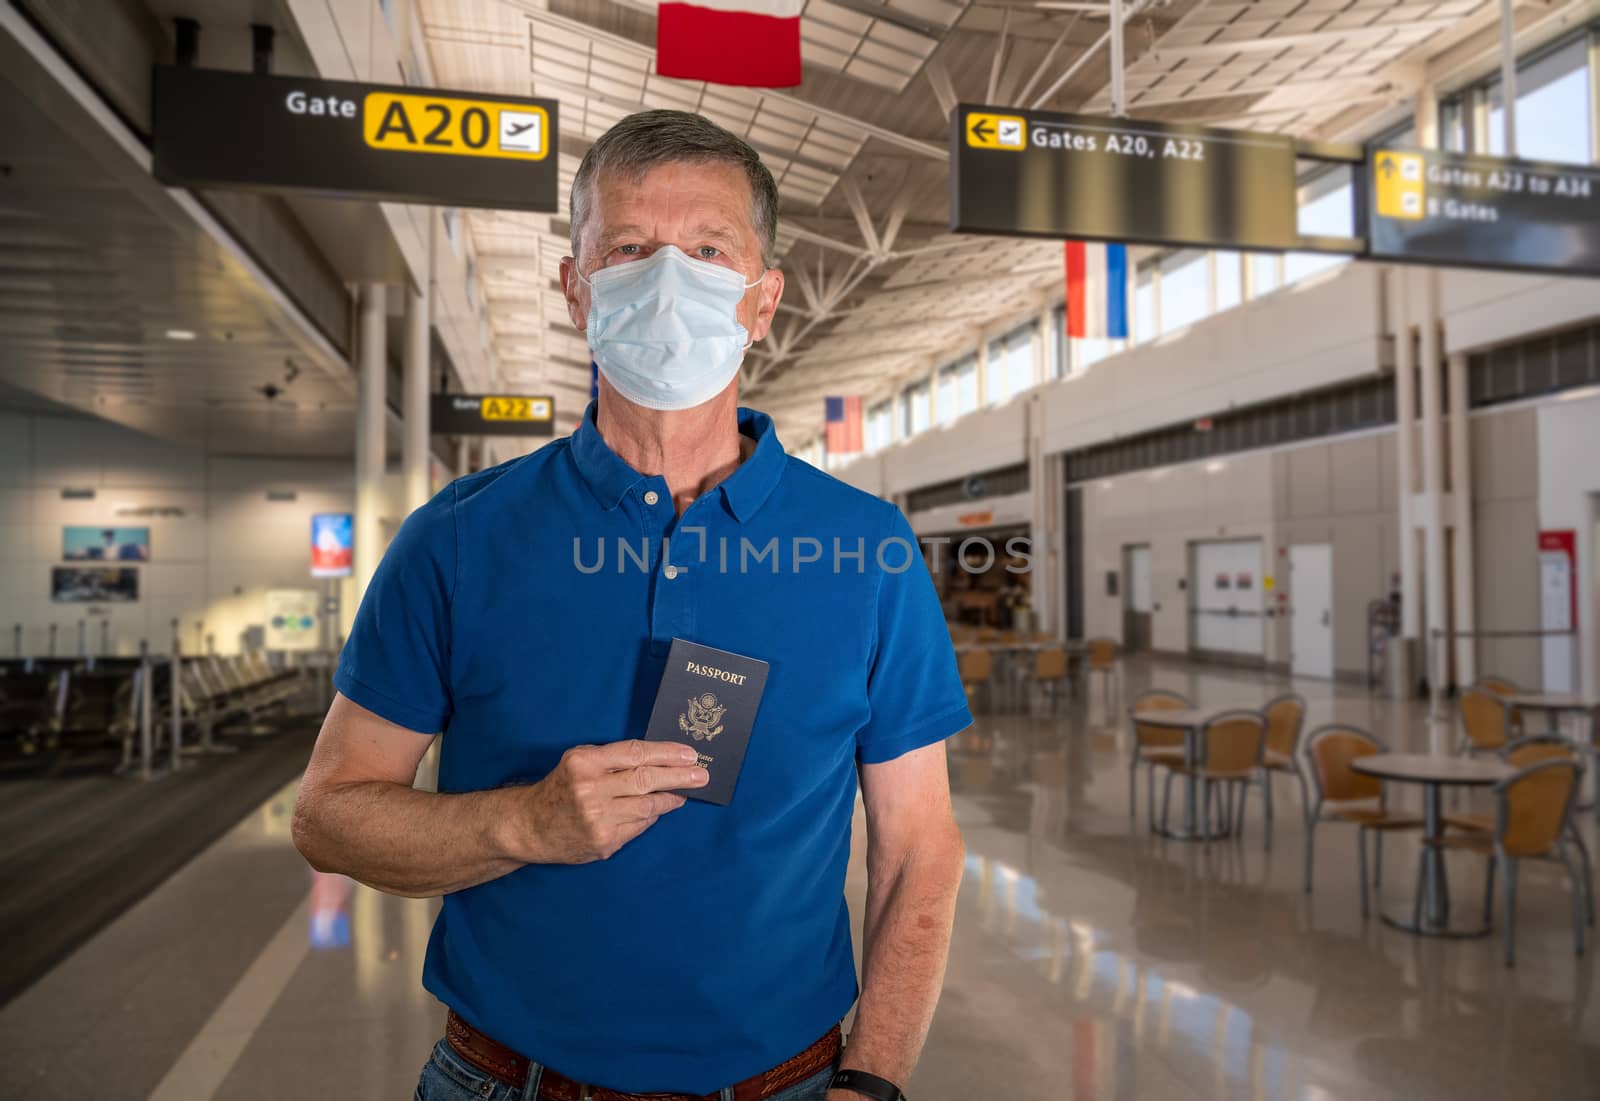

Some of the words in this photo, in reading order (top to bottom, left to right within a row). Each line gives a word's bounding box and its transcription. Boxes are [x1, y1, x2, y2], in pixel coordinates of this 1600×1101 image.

[286, 91, 356, 117] Gate
[375, 101, 490, 149] A20
[1032, 128, 1097, 150] Gates
[1105, 135, 1155, 157] A20,
[1162, 139, 1205, 160] A22
[1427, 166, 1481, 188] Gates
[1487, 170, 1524, 192] A23
[1529, 176, 1552, 195] to
[1444, 202, 1500, 222] Gates
[487, 400, 529, 417] A22
[686, 661, 747, 686] PASSPORT
